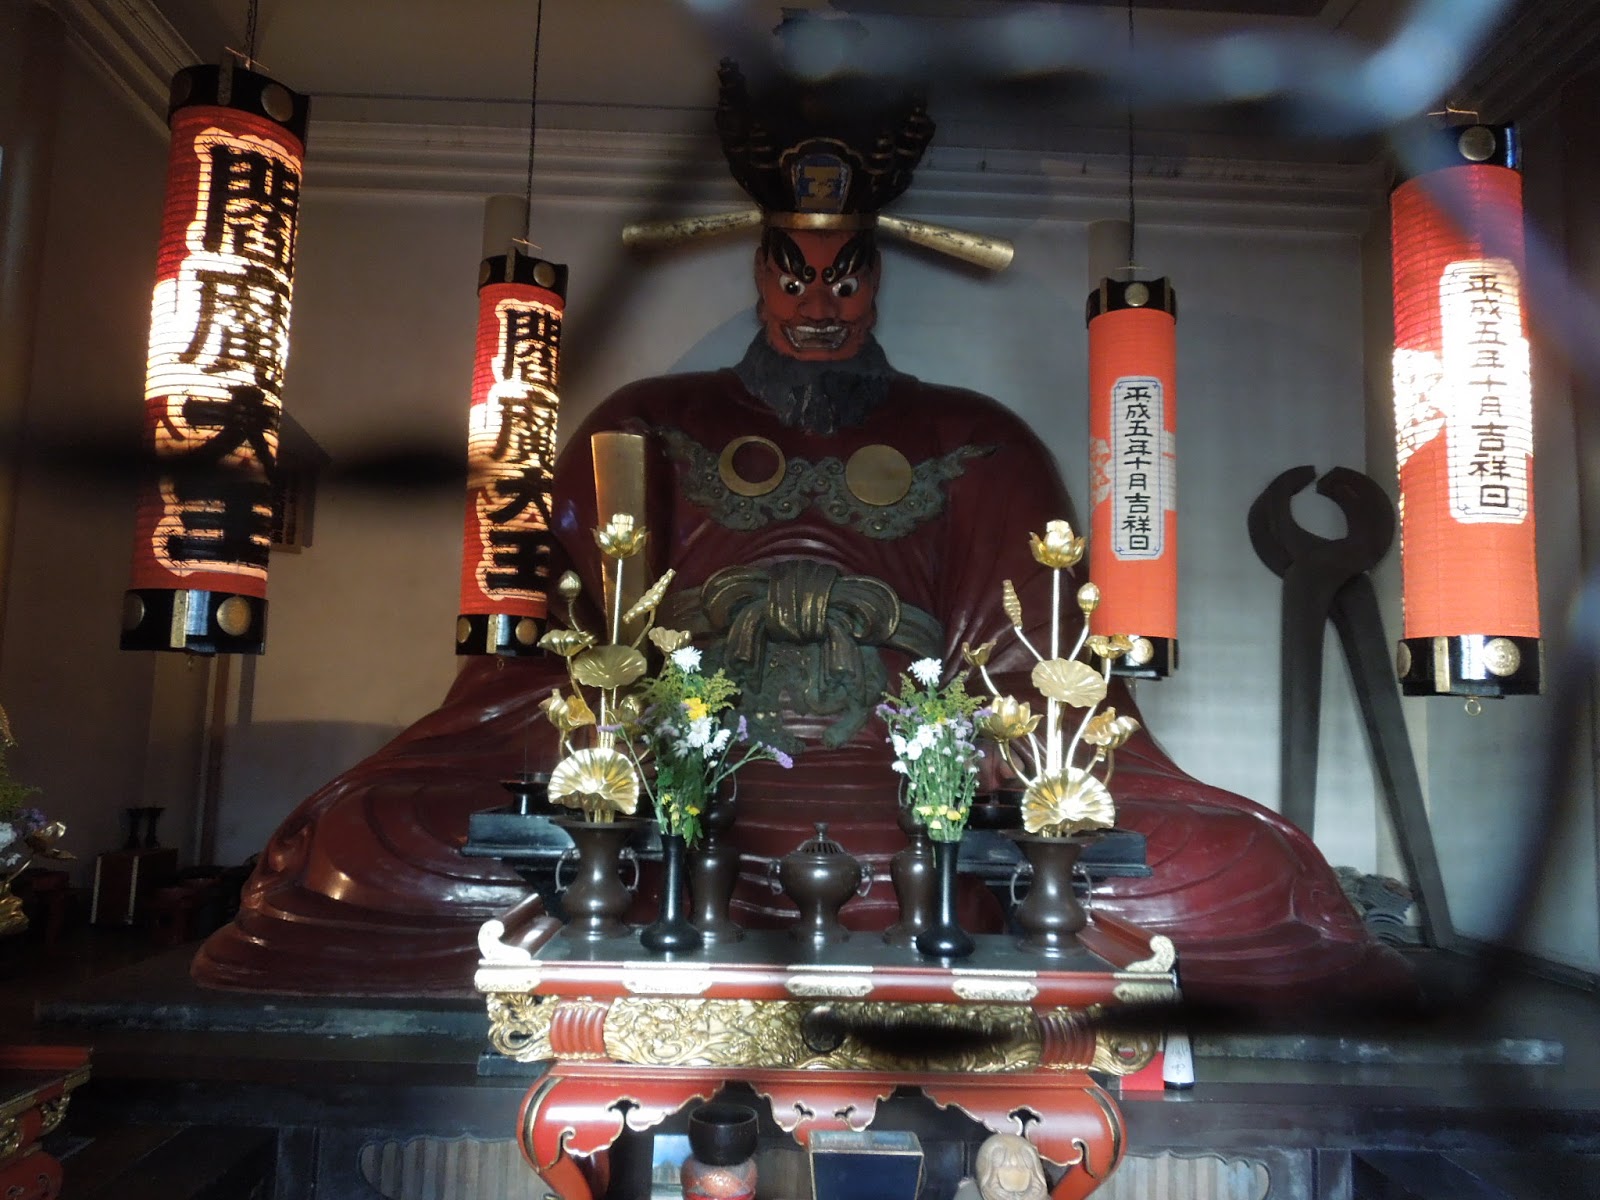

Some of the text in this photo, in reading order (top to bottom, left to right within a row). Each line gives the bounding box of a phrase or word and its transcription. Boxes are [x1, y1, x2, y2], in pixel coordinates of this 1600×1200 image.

[1122, 385, 1153, 551] 平成五年十月吉祥日
[1463, 274, 1511, 508] 平成五年十月吉祥日
